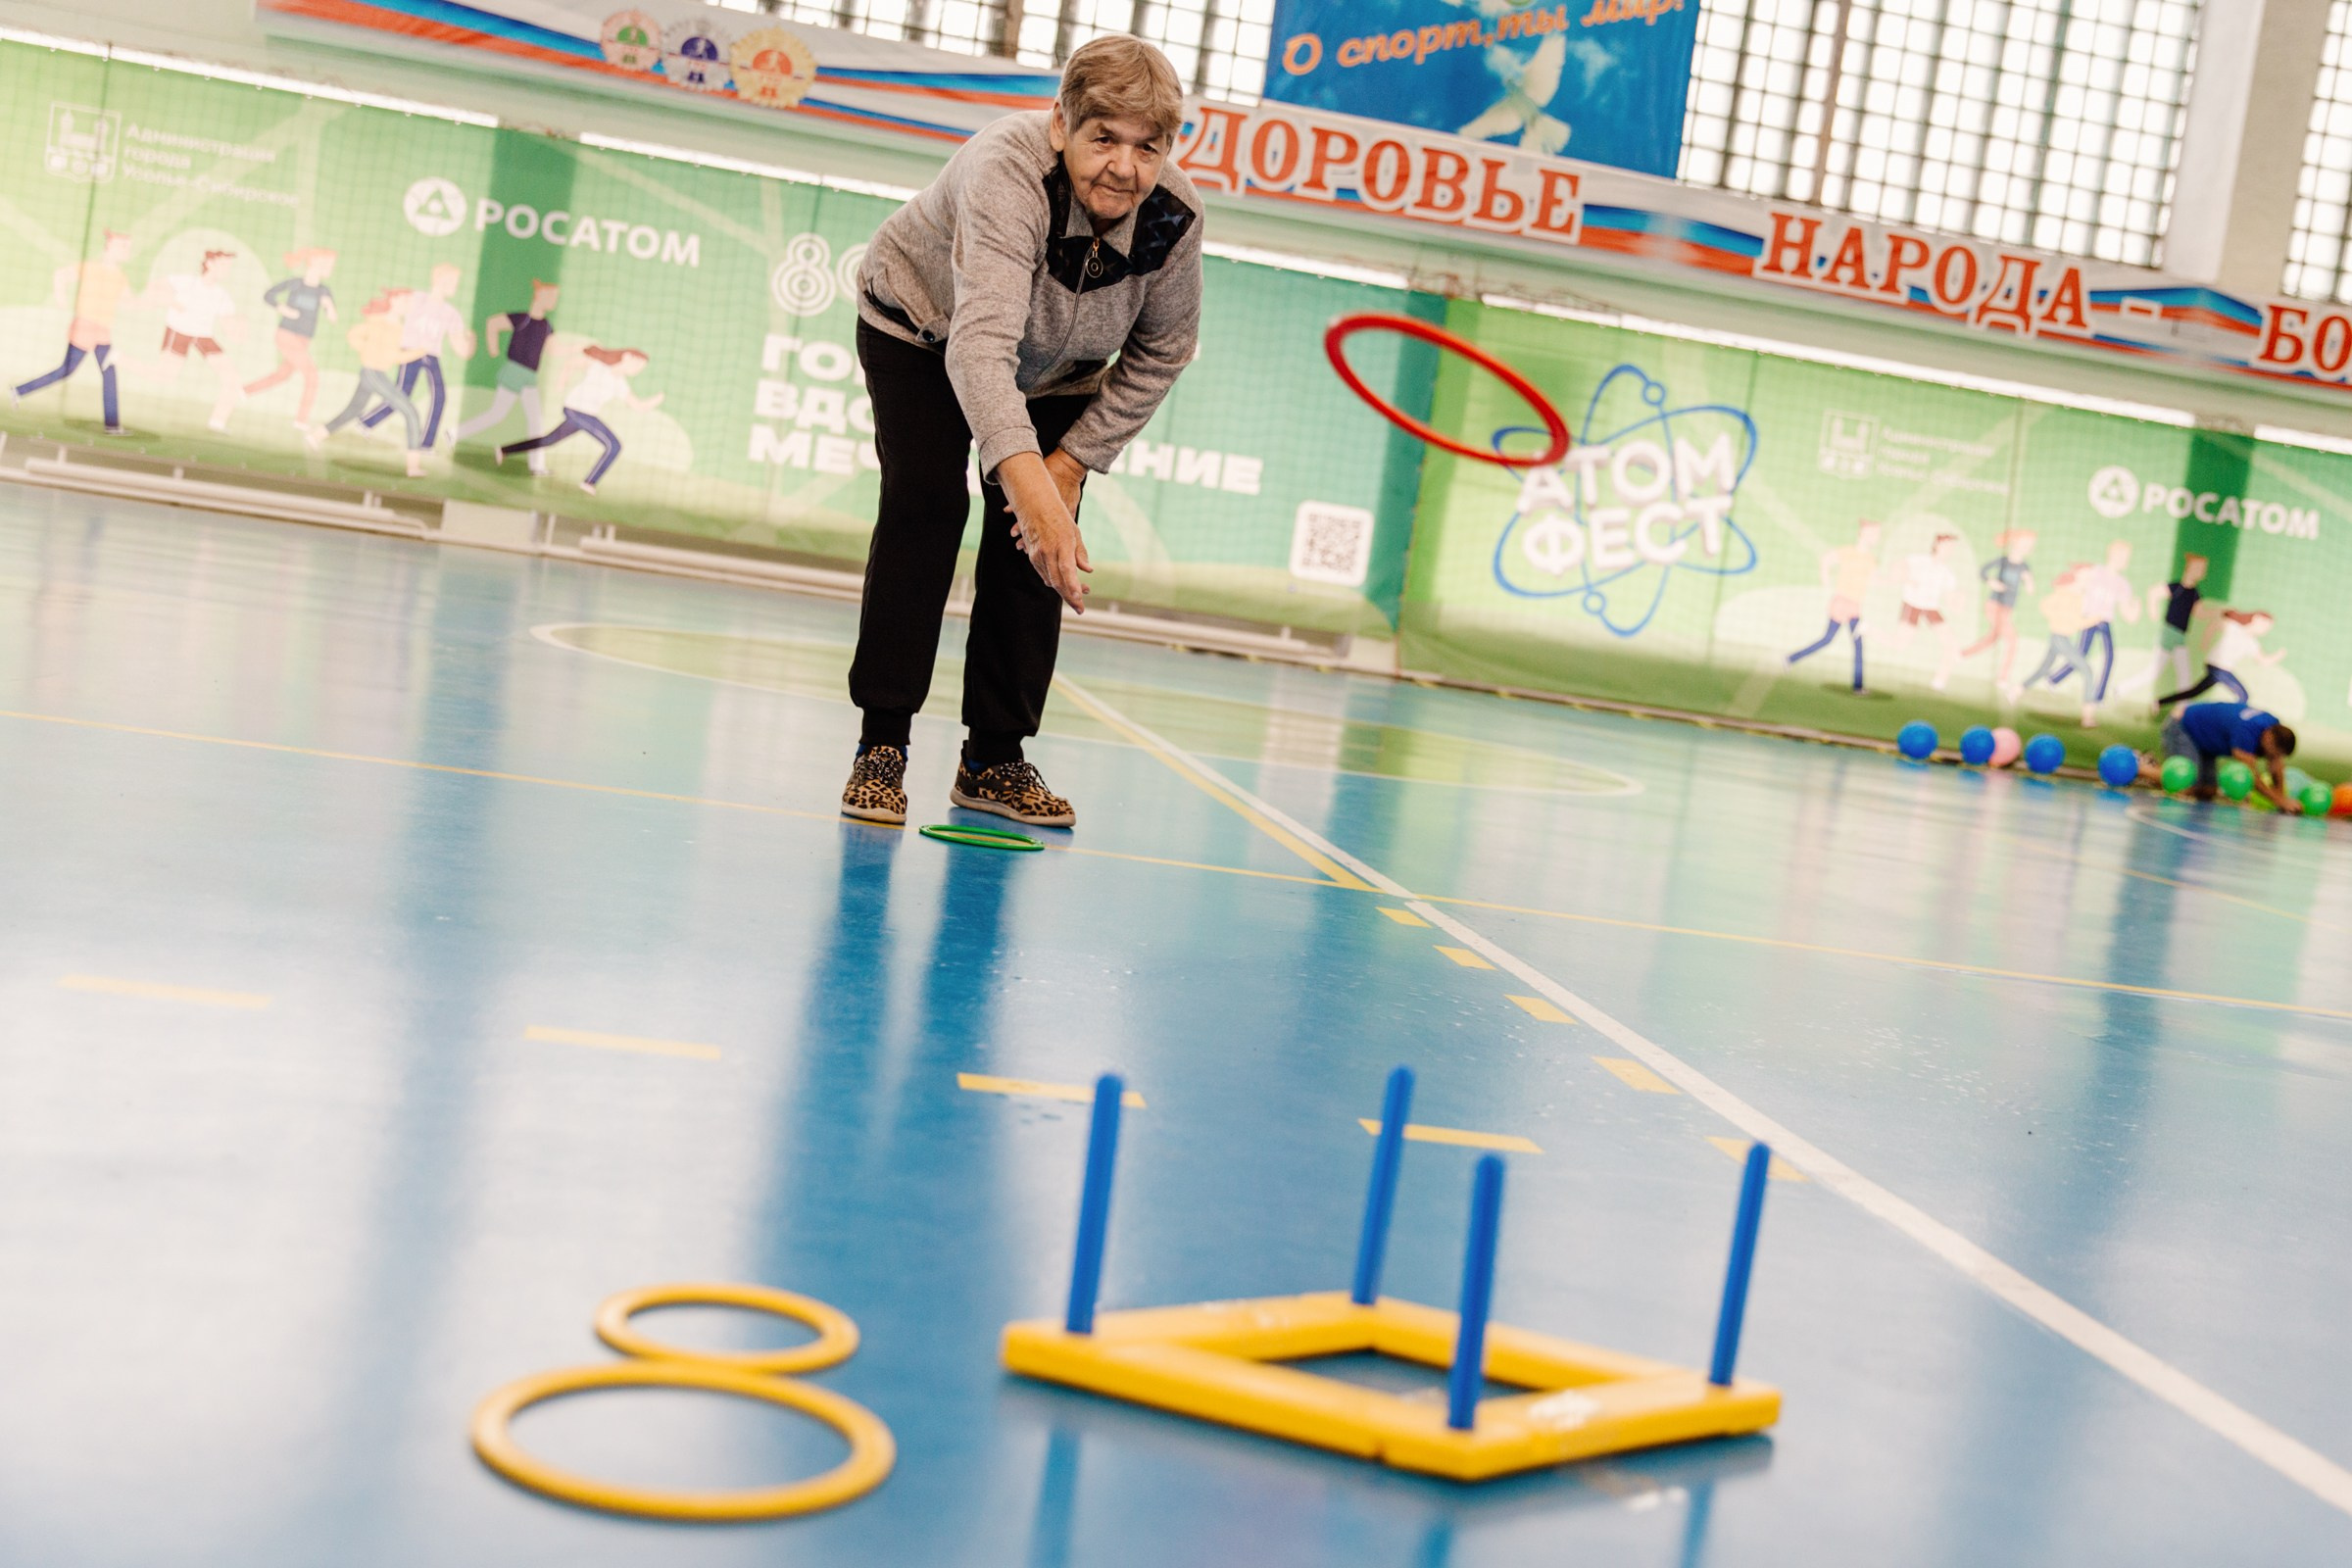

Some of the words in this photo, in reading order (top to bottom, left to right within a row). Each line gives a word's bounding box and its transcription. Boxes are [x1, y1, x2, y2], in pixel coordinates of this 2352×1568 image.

[1282, 32, 1323, 76] О
[473, 198, 702, 269] РОСАТОМ
[1761, 212, 2088, 335] НАРОДА
[2258, 303, 2352, 373] БО
[1515, 431, 1737, 516] АТОМ
[2141, 482, 2321, 540] РОСАТОМ
[1522, 493, 1734, 579] ФЕСТ
